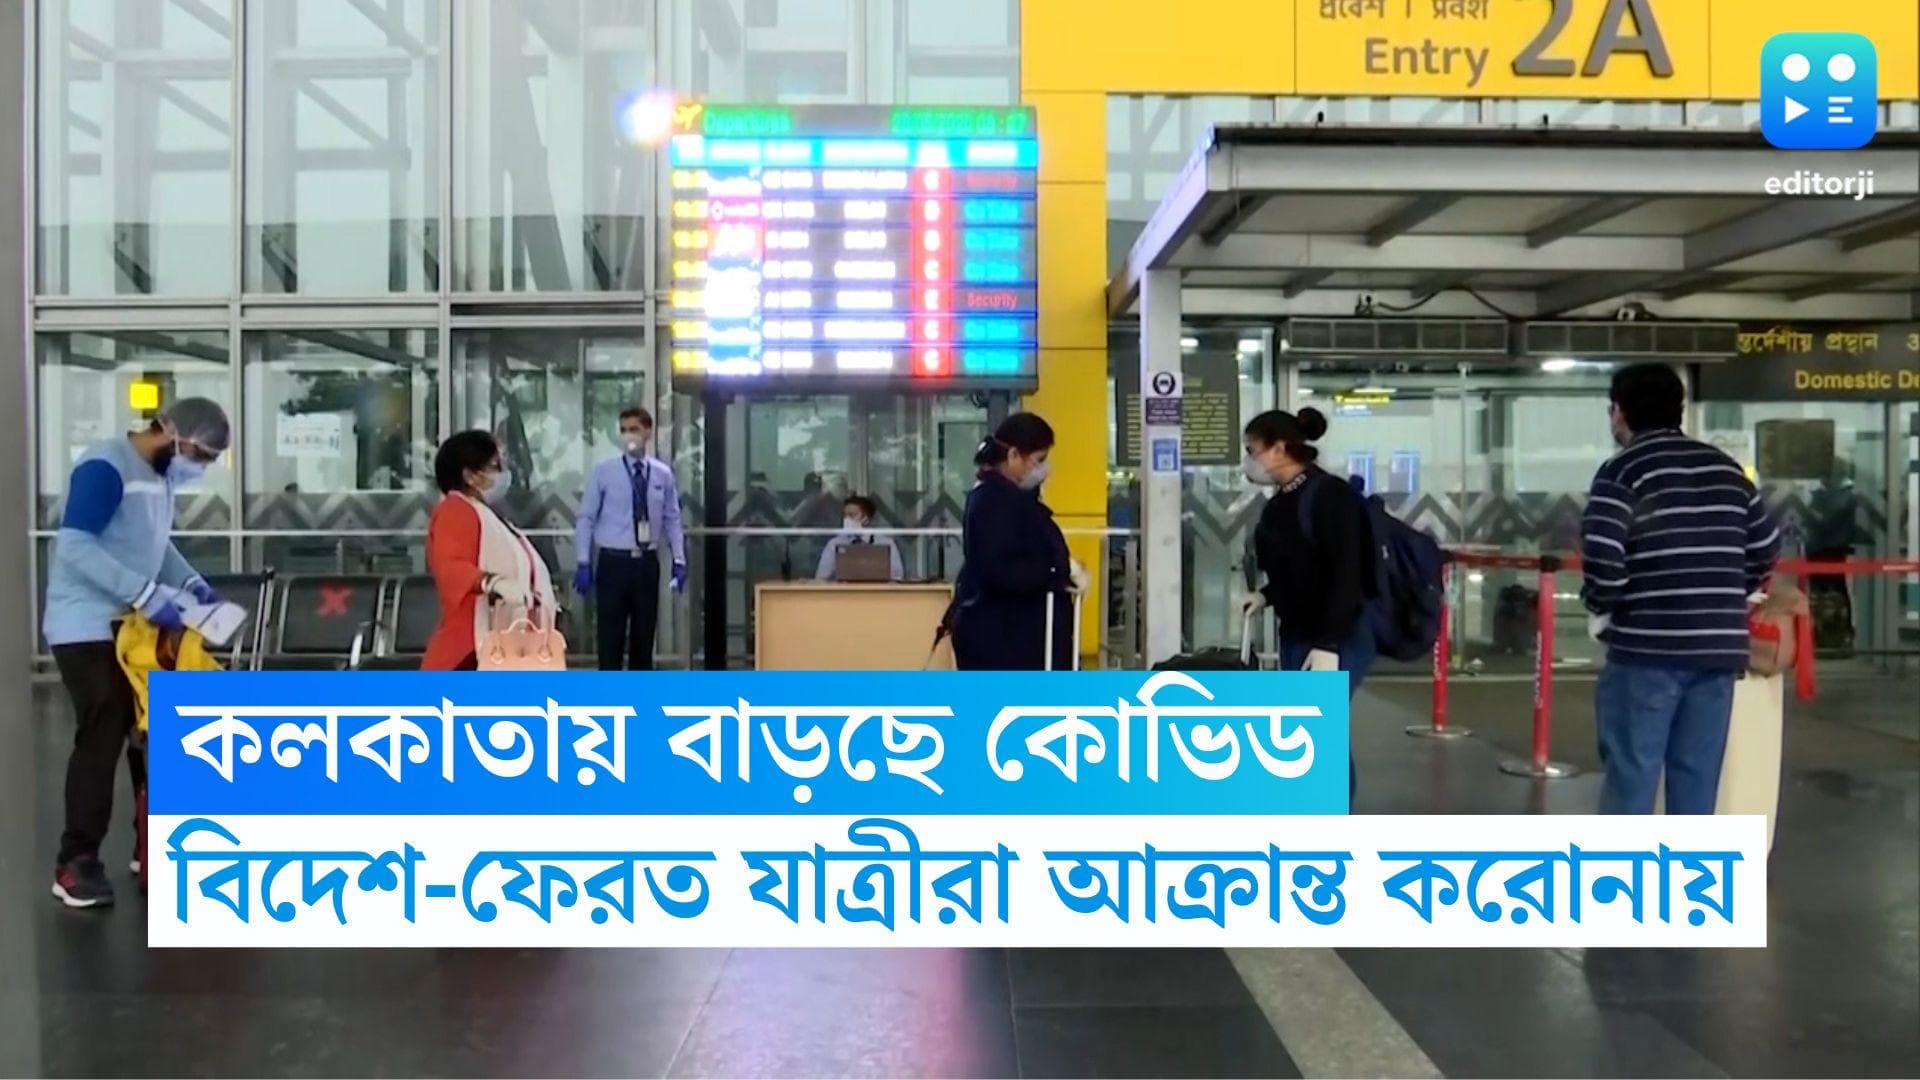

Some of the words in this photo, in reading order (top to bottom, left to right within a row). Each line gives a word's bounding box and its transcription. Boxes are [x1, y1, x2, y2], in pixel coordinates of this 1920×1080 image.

[1511, 0, 1674, 78] 2A
[1365, 38, 1489, 88] Entry
[1737, 326, 1813, 353] ন্তর্দেশীয়
[1795, 369, 1892, 389] Domestic
